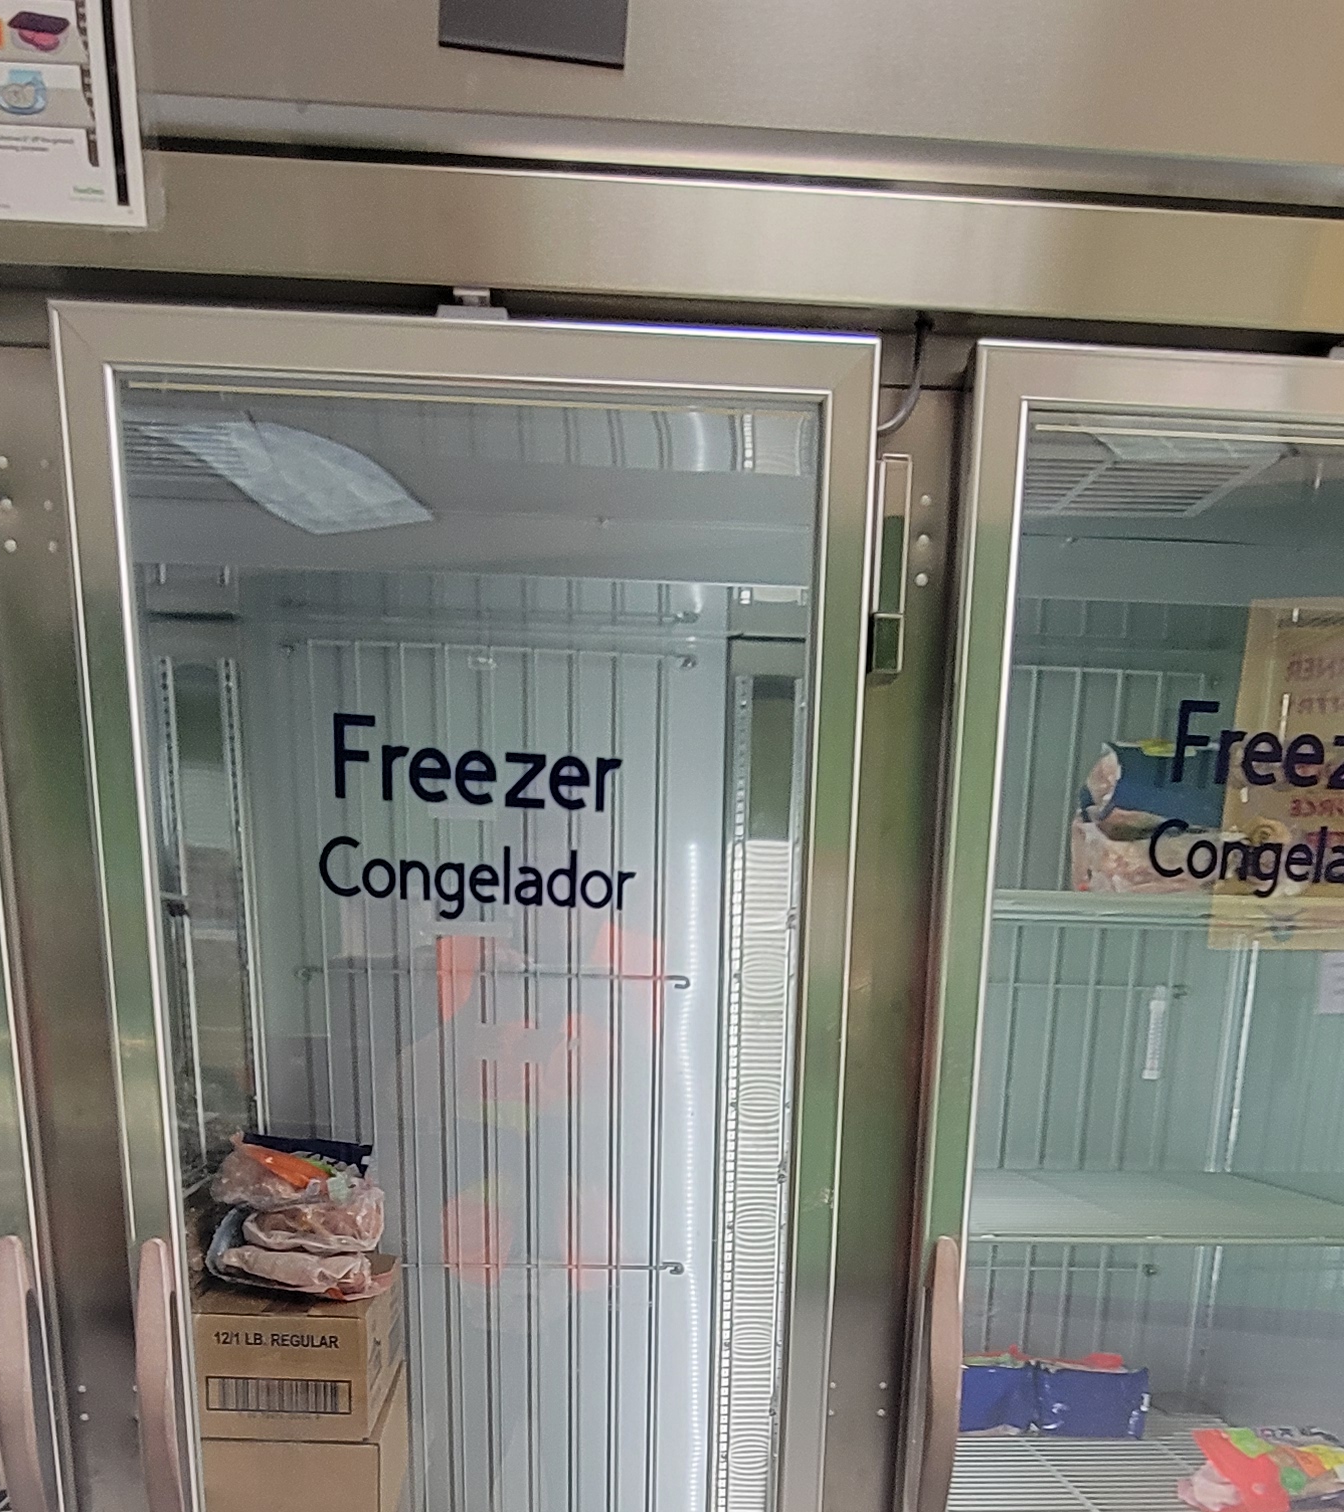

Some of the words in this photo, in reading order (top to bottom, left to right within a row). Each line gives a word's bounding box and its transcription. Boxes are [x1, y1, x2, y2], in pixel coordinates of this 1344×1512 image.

[333, 712, 623, 812] Freezer
[319, 835, 637, 919] Congelador
[214, 1331, 241, 1346] 12/1
[270, 1333, 340, 1349] REGULAR
